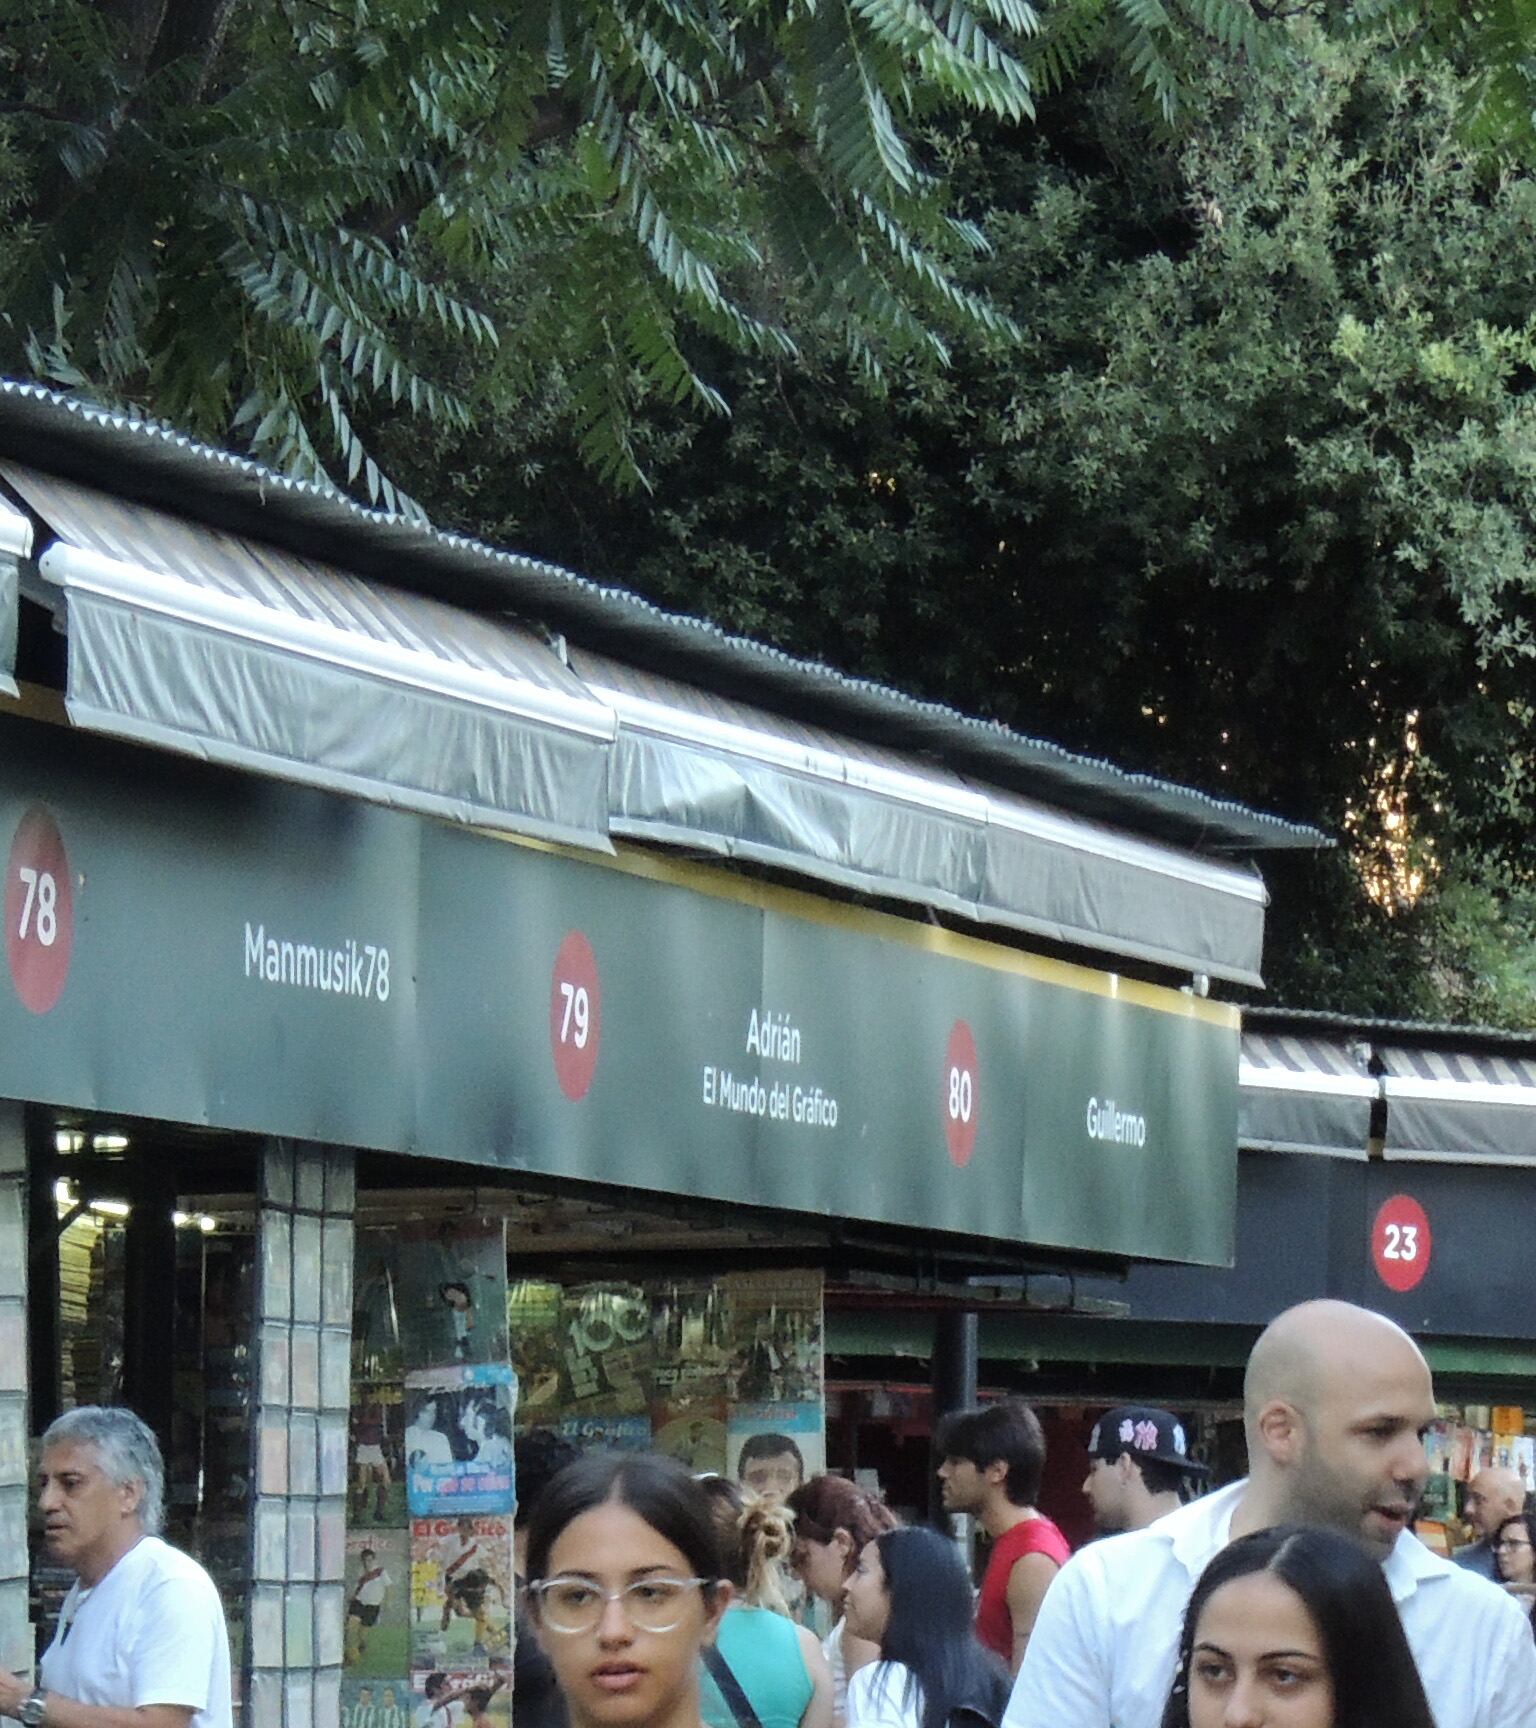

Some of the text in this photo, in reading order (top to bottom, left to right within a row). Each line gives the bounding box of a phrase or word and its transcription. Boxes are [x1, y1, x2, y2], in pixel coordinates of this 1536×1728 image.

[19, 867, 57, 946] 78
[244, 921, 390, 1002] Manmusik78
[560, 982, 589, 1049] 79
[746, 1009, 801, 1064] Adrián
[702, 1066, 838, 1128] El Mundo del Gráfico
[949, 1067, 972, 1123] 80
[1086, 1097, 1146, 1148] Guillermo
[1384, 1224, 1418, 1261] 23
